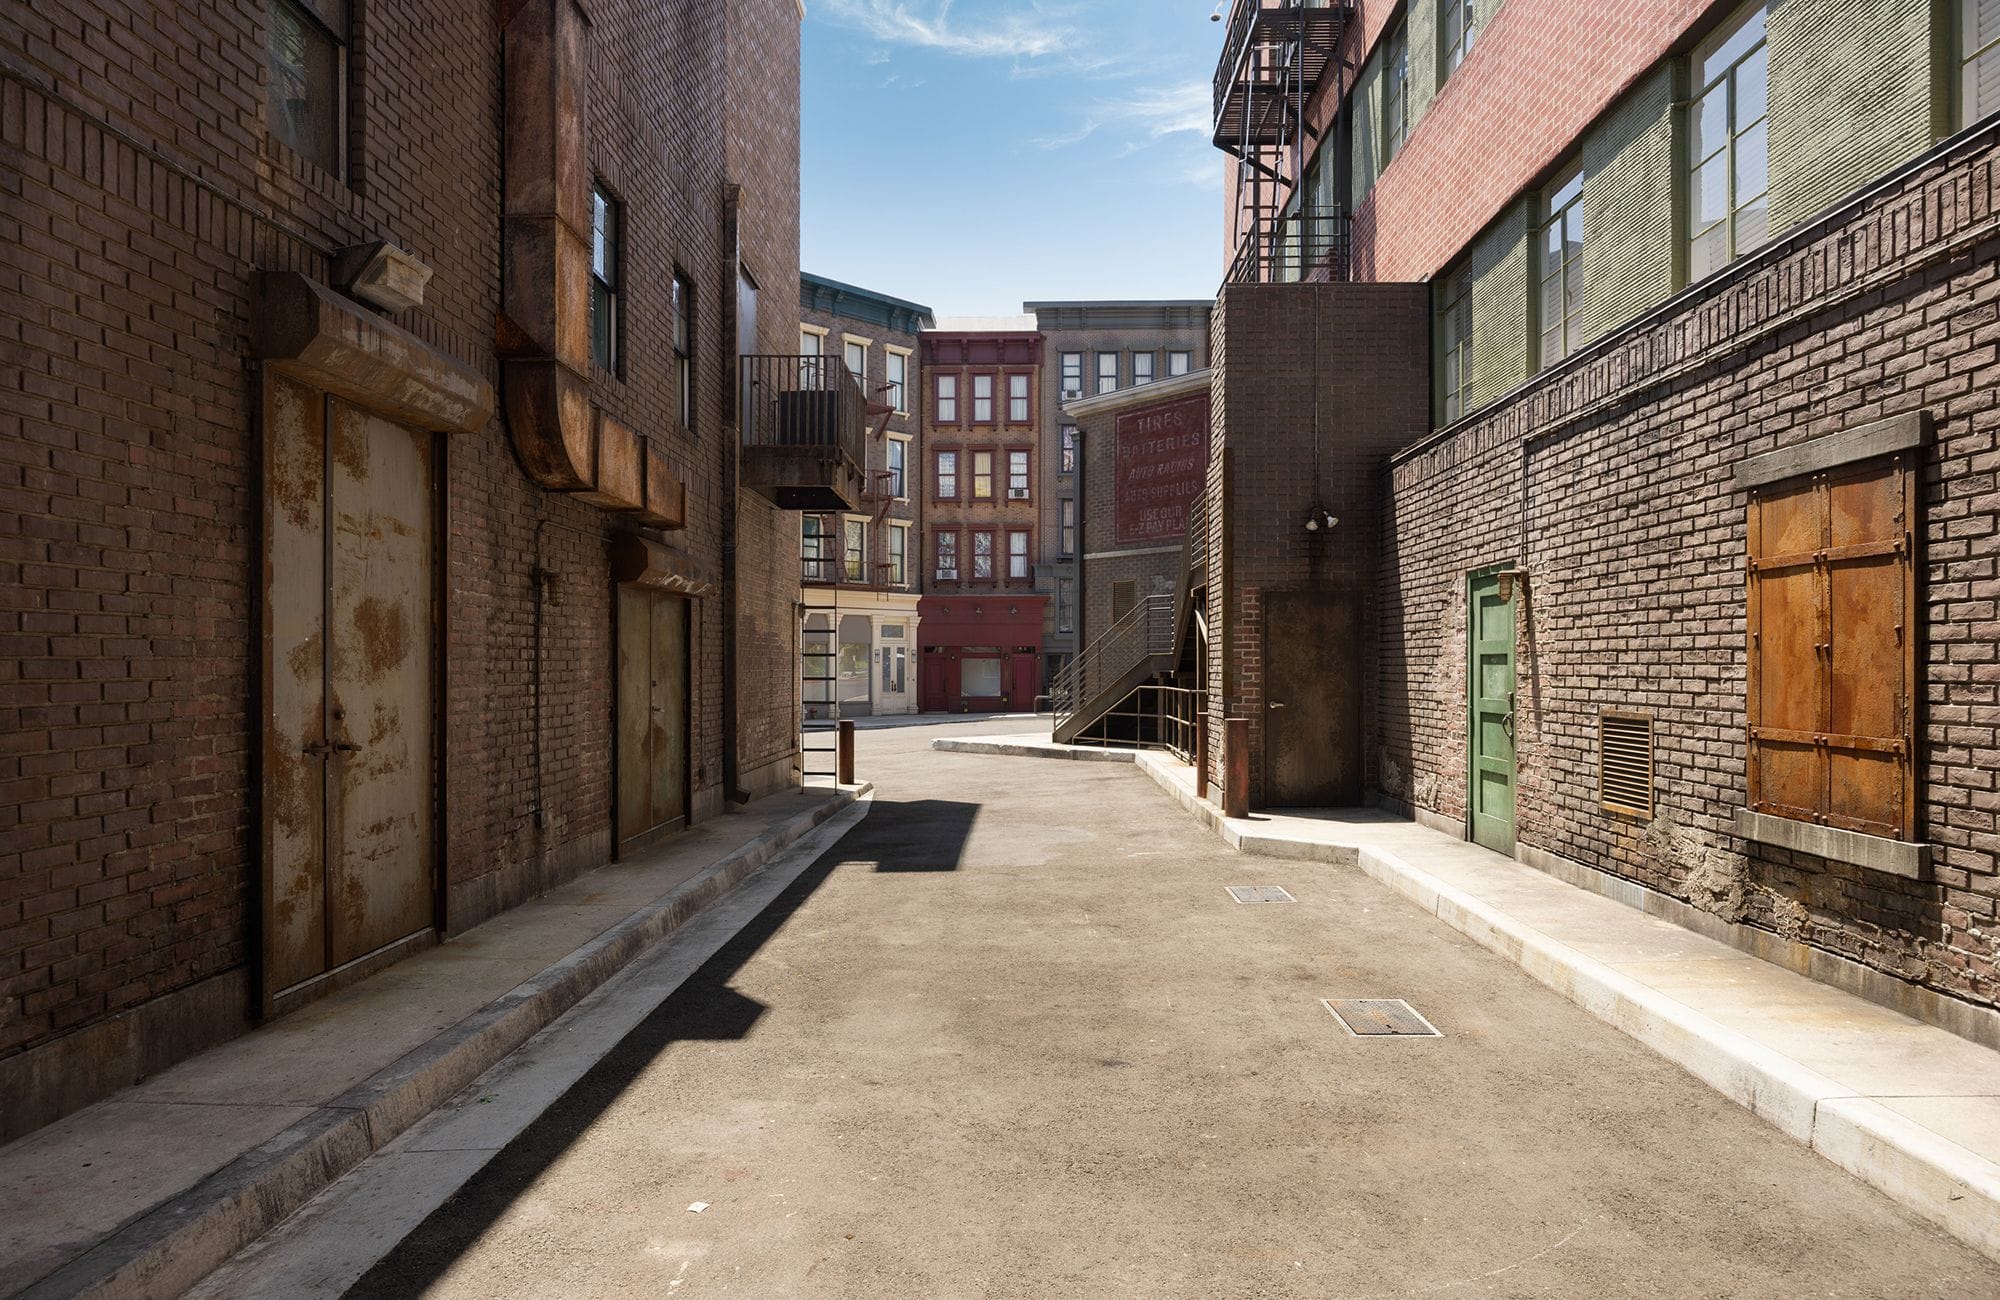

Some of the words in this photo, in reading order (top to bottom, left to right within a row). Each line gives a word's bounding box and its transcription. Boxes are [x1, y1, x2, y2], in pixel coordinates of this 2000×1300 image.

[1137, 411, 1182, 434] TIRES
[1121, 432, 1200, 459] BATTERIES
[1128, 464, 1155, 481] AUTO
[1139, 508, 1159, 522] USE
[1160, 505, 1182, 519] OUR
[1146, 519, 1164, 534] PAY
